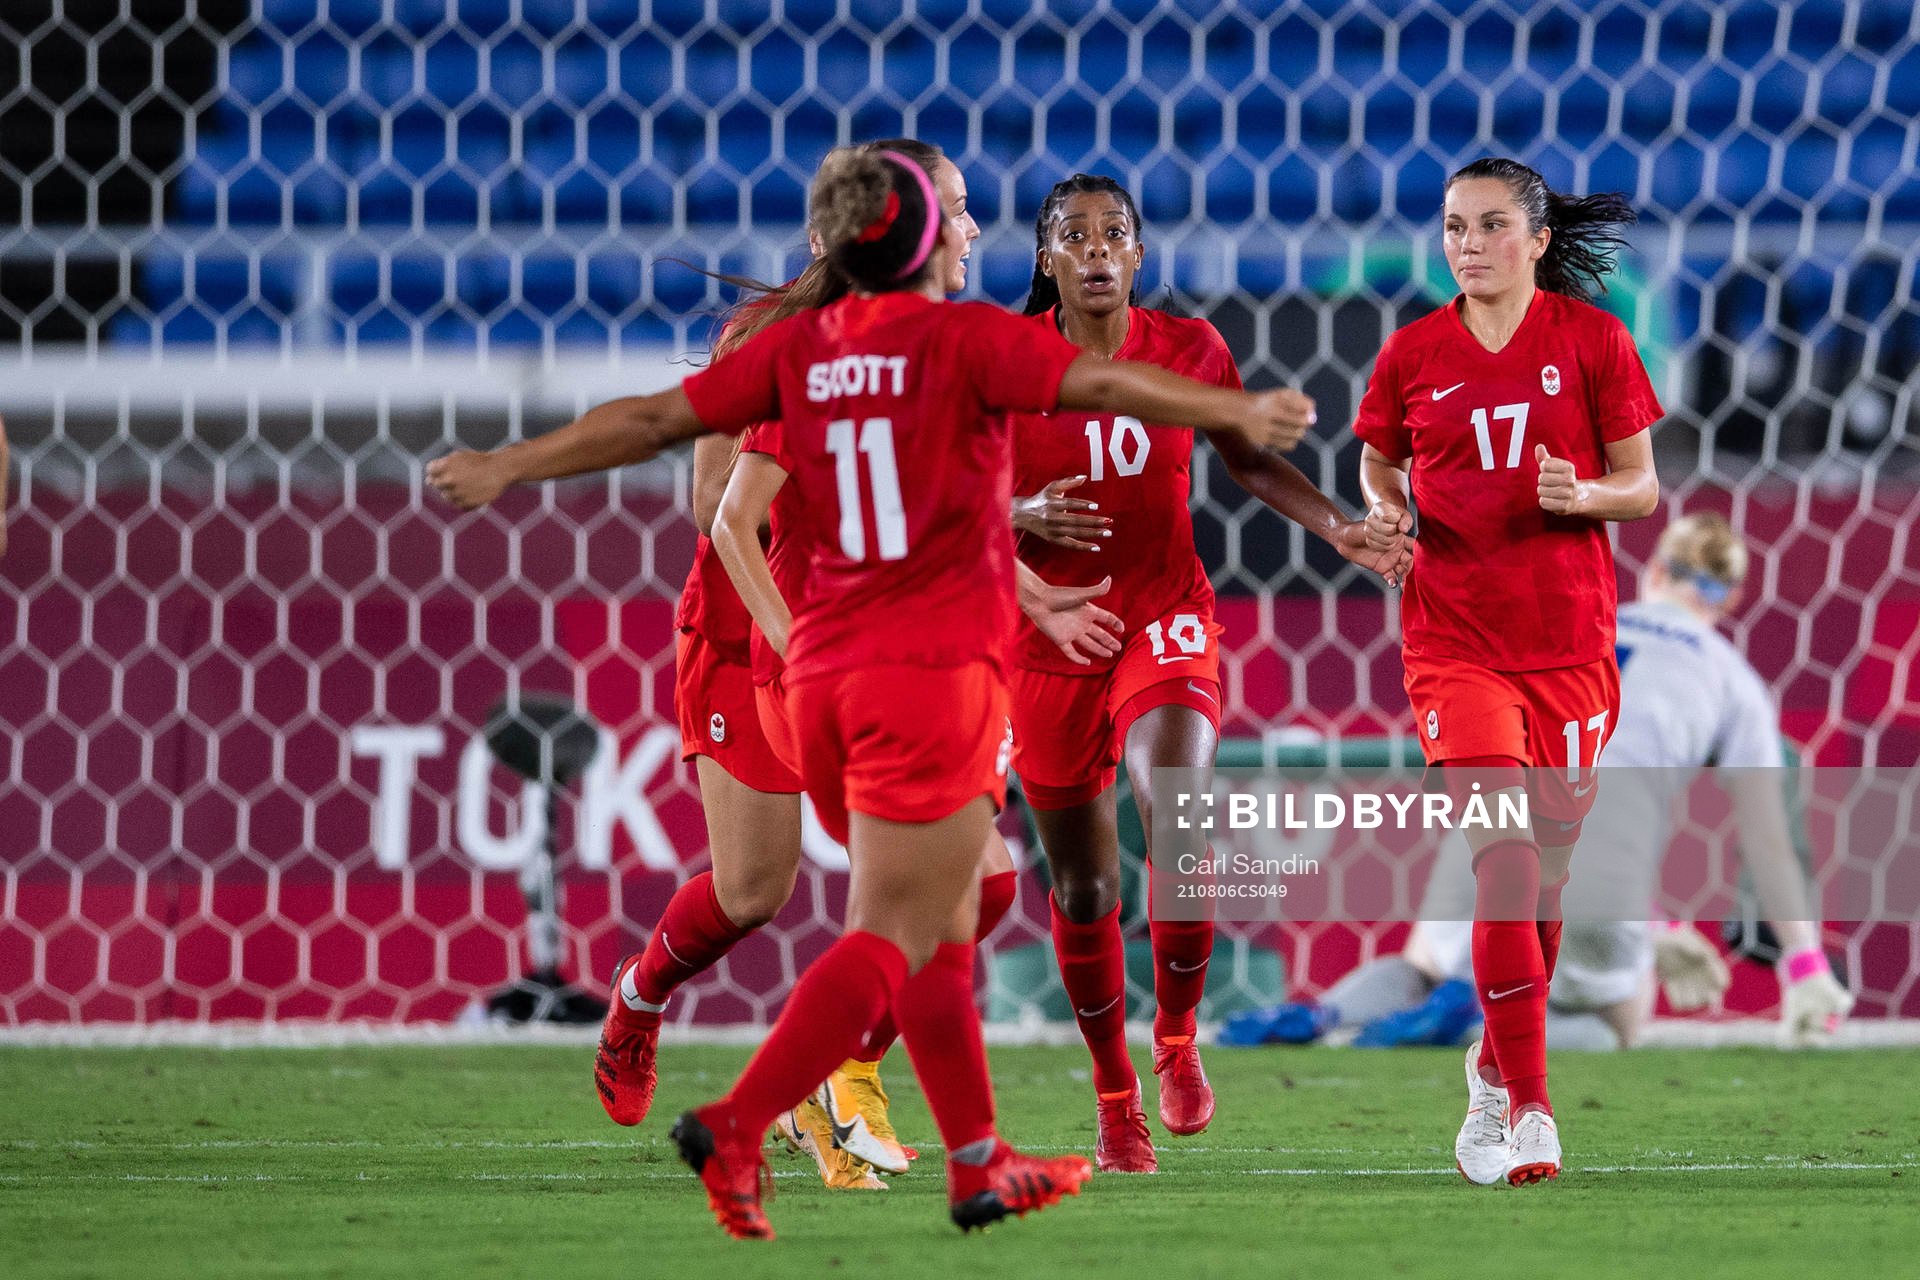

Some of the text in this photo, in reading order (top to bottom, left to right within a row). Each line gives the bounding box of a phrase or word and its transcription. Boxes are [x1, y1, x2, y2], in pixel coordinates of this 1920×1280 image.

[807, 354, 908, 402] SCOTT
[1084, 415, 1151, 482] 10
[1470, 402, 1530, 471] 17
[825, 417, 909, 563] 11
[1145, 614, 1208, 656] 10
[1562, 709, 1610, 784] 17
